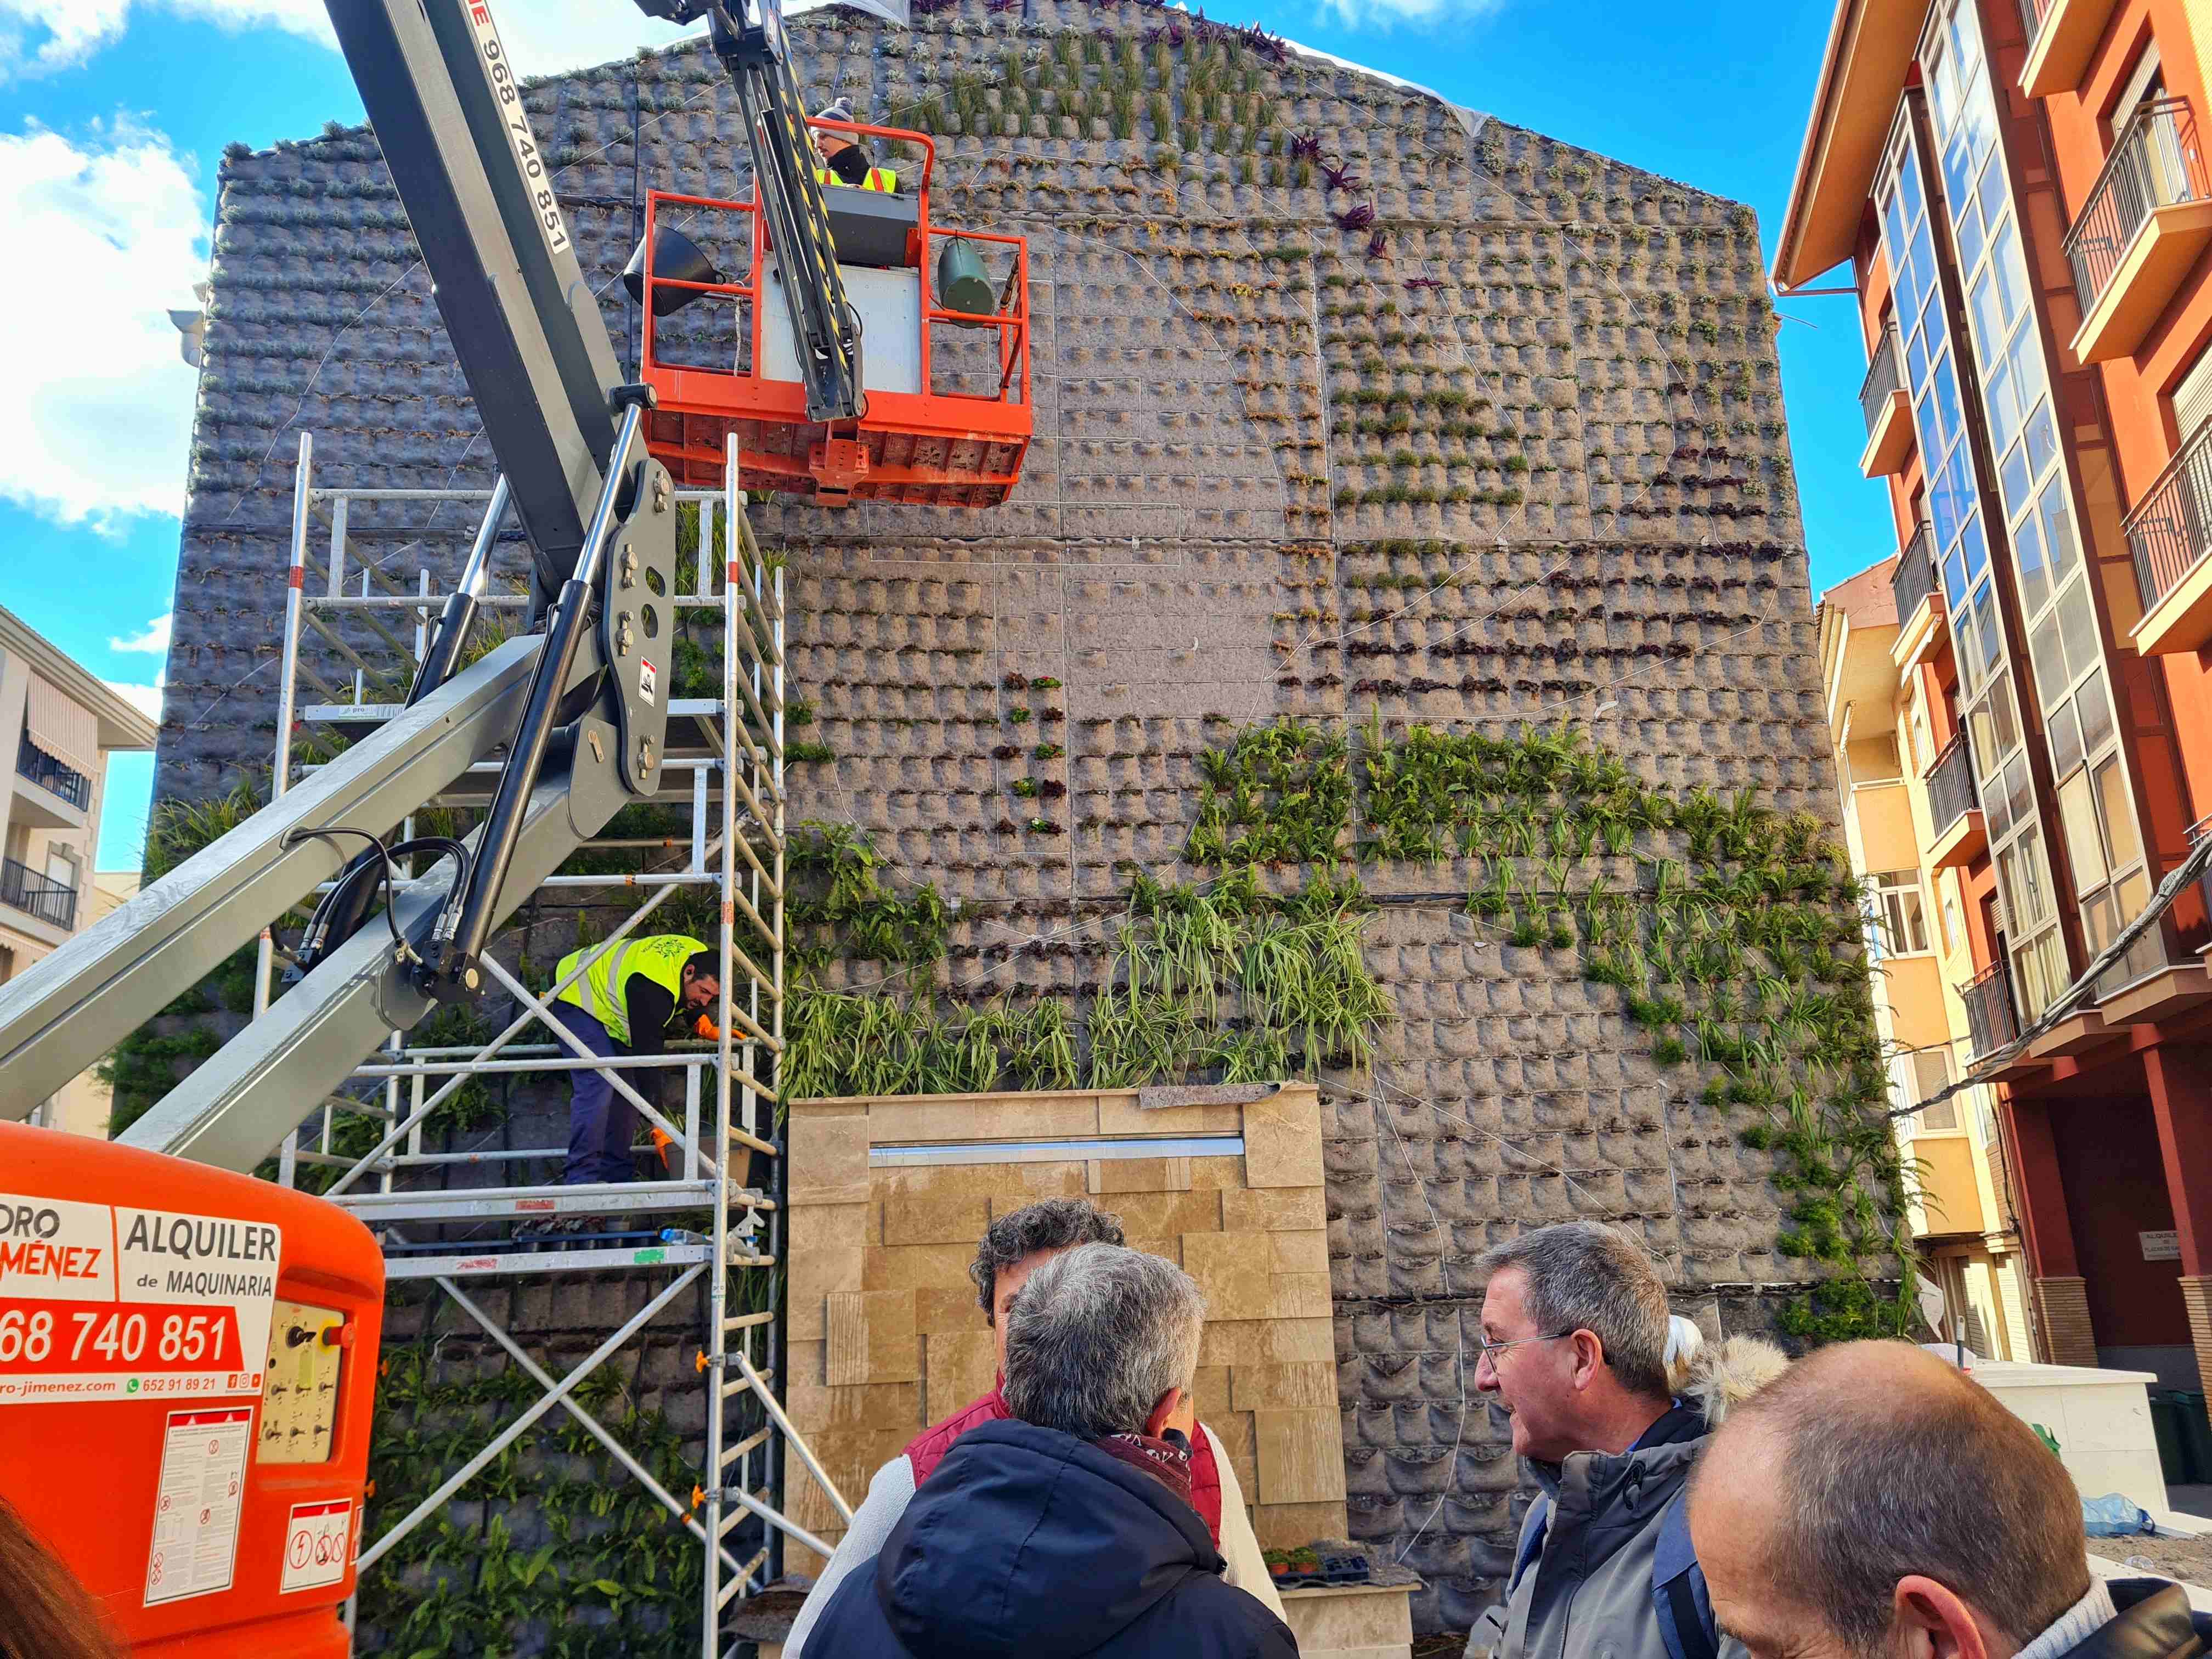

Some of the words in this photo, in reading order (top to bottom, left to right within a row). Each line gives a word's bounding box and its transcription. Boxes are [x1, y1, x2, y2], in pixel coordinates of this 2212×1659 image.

[483, 40, 515, 105] 968
[511, 115, 541, 178] 740
[537, 190, 566, 247] 851
[124, 1214, 276, 1262] ALQUILER
[0, 1240, 102, 1283] MÉNEZ
[137, 1274, 158, 1288] de
[166, 1270, 272, 1296] MAQUINARIA
[0, 1310, 53, 1362] 68
[71, 1312, 146, 1361] 740
[159, 1314, 226, 1361] 851
[143, 1379, 165, 1391] 652
[168, 1378, 181, 1391] 91
[185, 1378, 200, 1390] 89
[202, 1378, 216, 1390] 21
